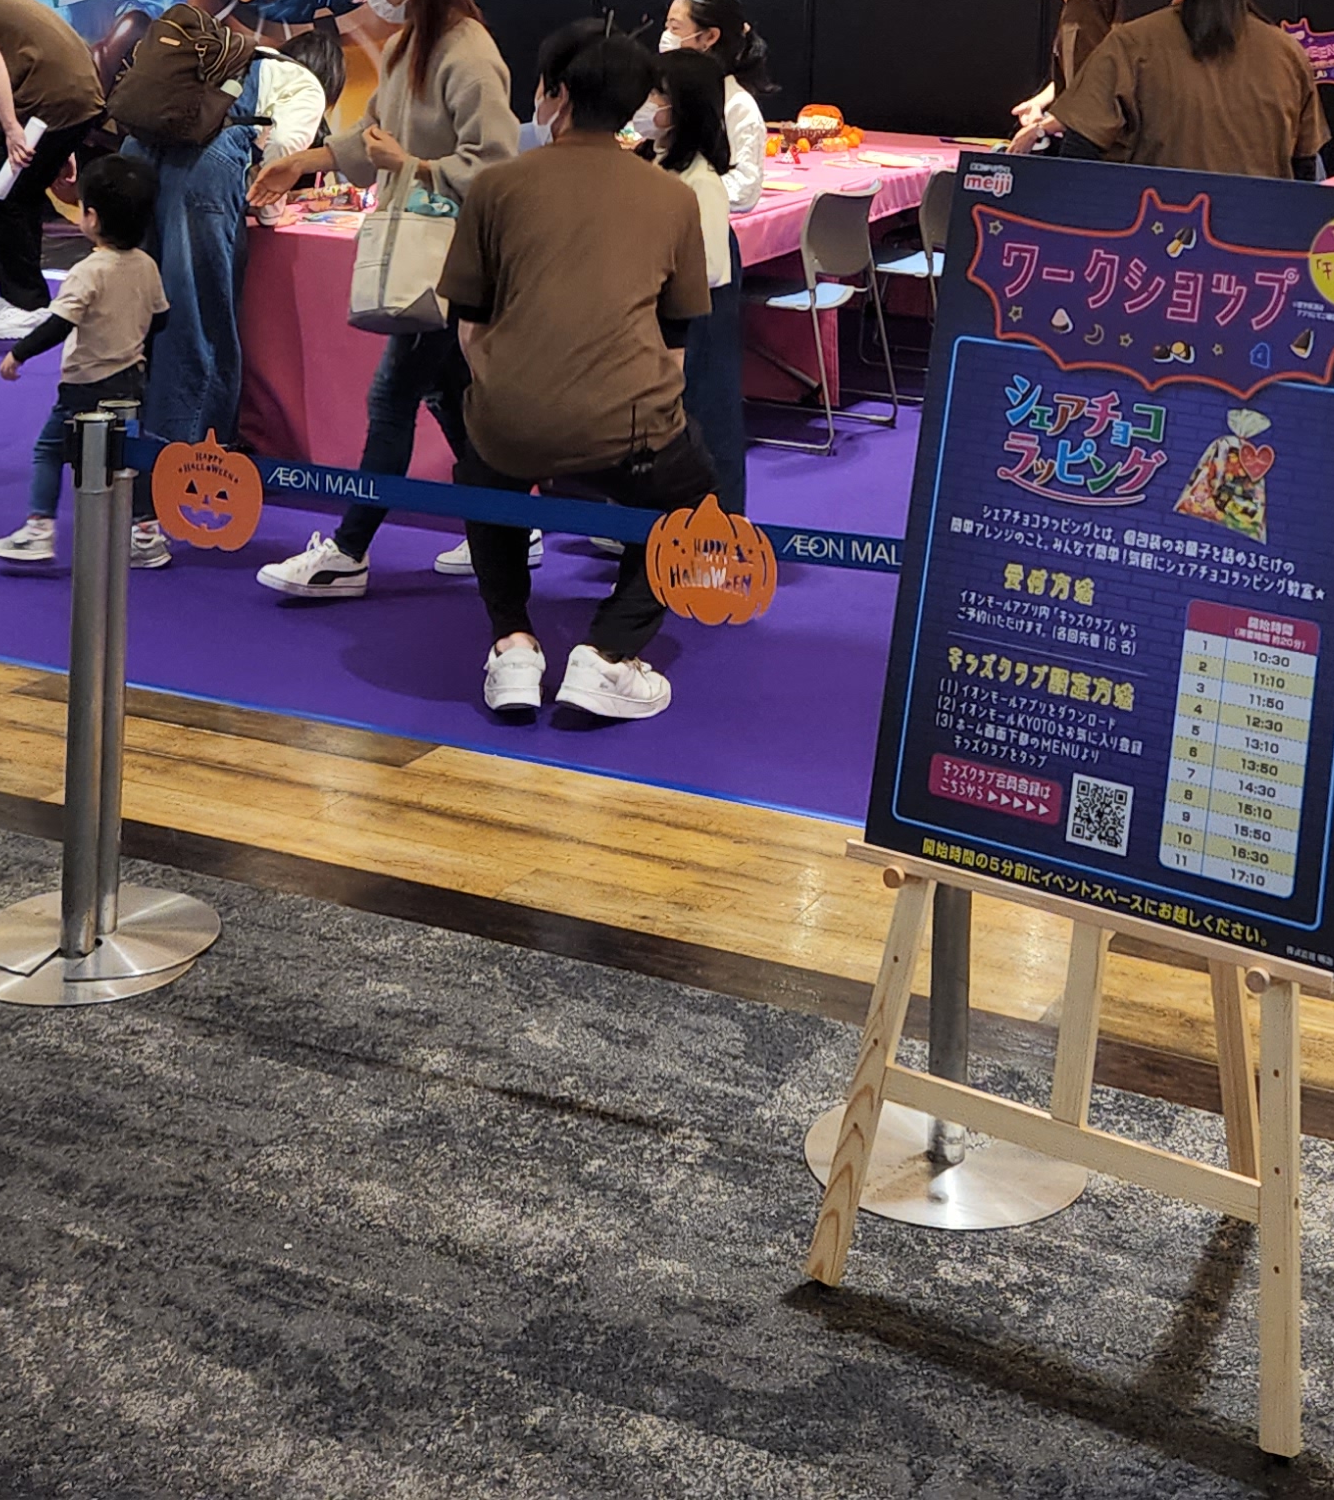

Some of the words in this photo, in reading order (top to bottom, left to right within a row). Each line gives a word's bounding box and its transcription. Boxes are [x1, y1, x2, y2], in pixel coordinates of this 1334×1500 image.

[966, 173, 1011, 195] meiji
[1002, 242, 1300, 331] ワークショップ
[1005, 374, 1166, 447] シェアチョコ
[997, 431, 1168, 504] ラッピング
[325, 475, 380, 500] MALL
[1202, 641, 1208, 651] 1
[1253, 651, 1290, 667] 10:30
[1199, 661, 1207, 672] 2
[1253, 673, 1285, 689] 11:10
[1196, 683, 1205, 693] 3
[1249, 694, 1284, 711] 11:50
[1194, 704, 1202, 714] 4
[1246, 715, 1283, 732] 12:30
[1191, 725, 1200, 736] 5
[1244, 737, 1279, 754] 13:10
[1188, 747, 1198, 758] 6
[1241, 758, 1278, 776] 13:50
[940, 777, 984, 800] こちらから
[1186, 768, 1195, 779] 7
[1238, 780, 1276, 798] 14:30
[1184, 790, 1193, 800] 8
[1237, 802, 1272, 820] 15:10
[1181, 811, 1191, 822] 9
[1234, 824, 1271, 842] 15:50
[1176, 832, 1192, 845] 10
[1231, 845, 1269, 864] 16:30
[1175, 853, 1187, 866] 11
[1230, 869, 1265, 887] 17:10
